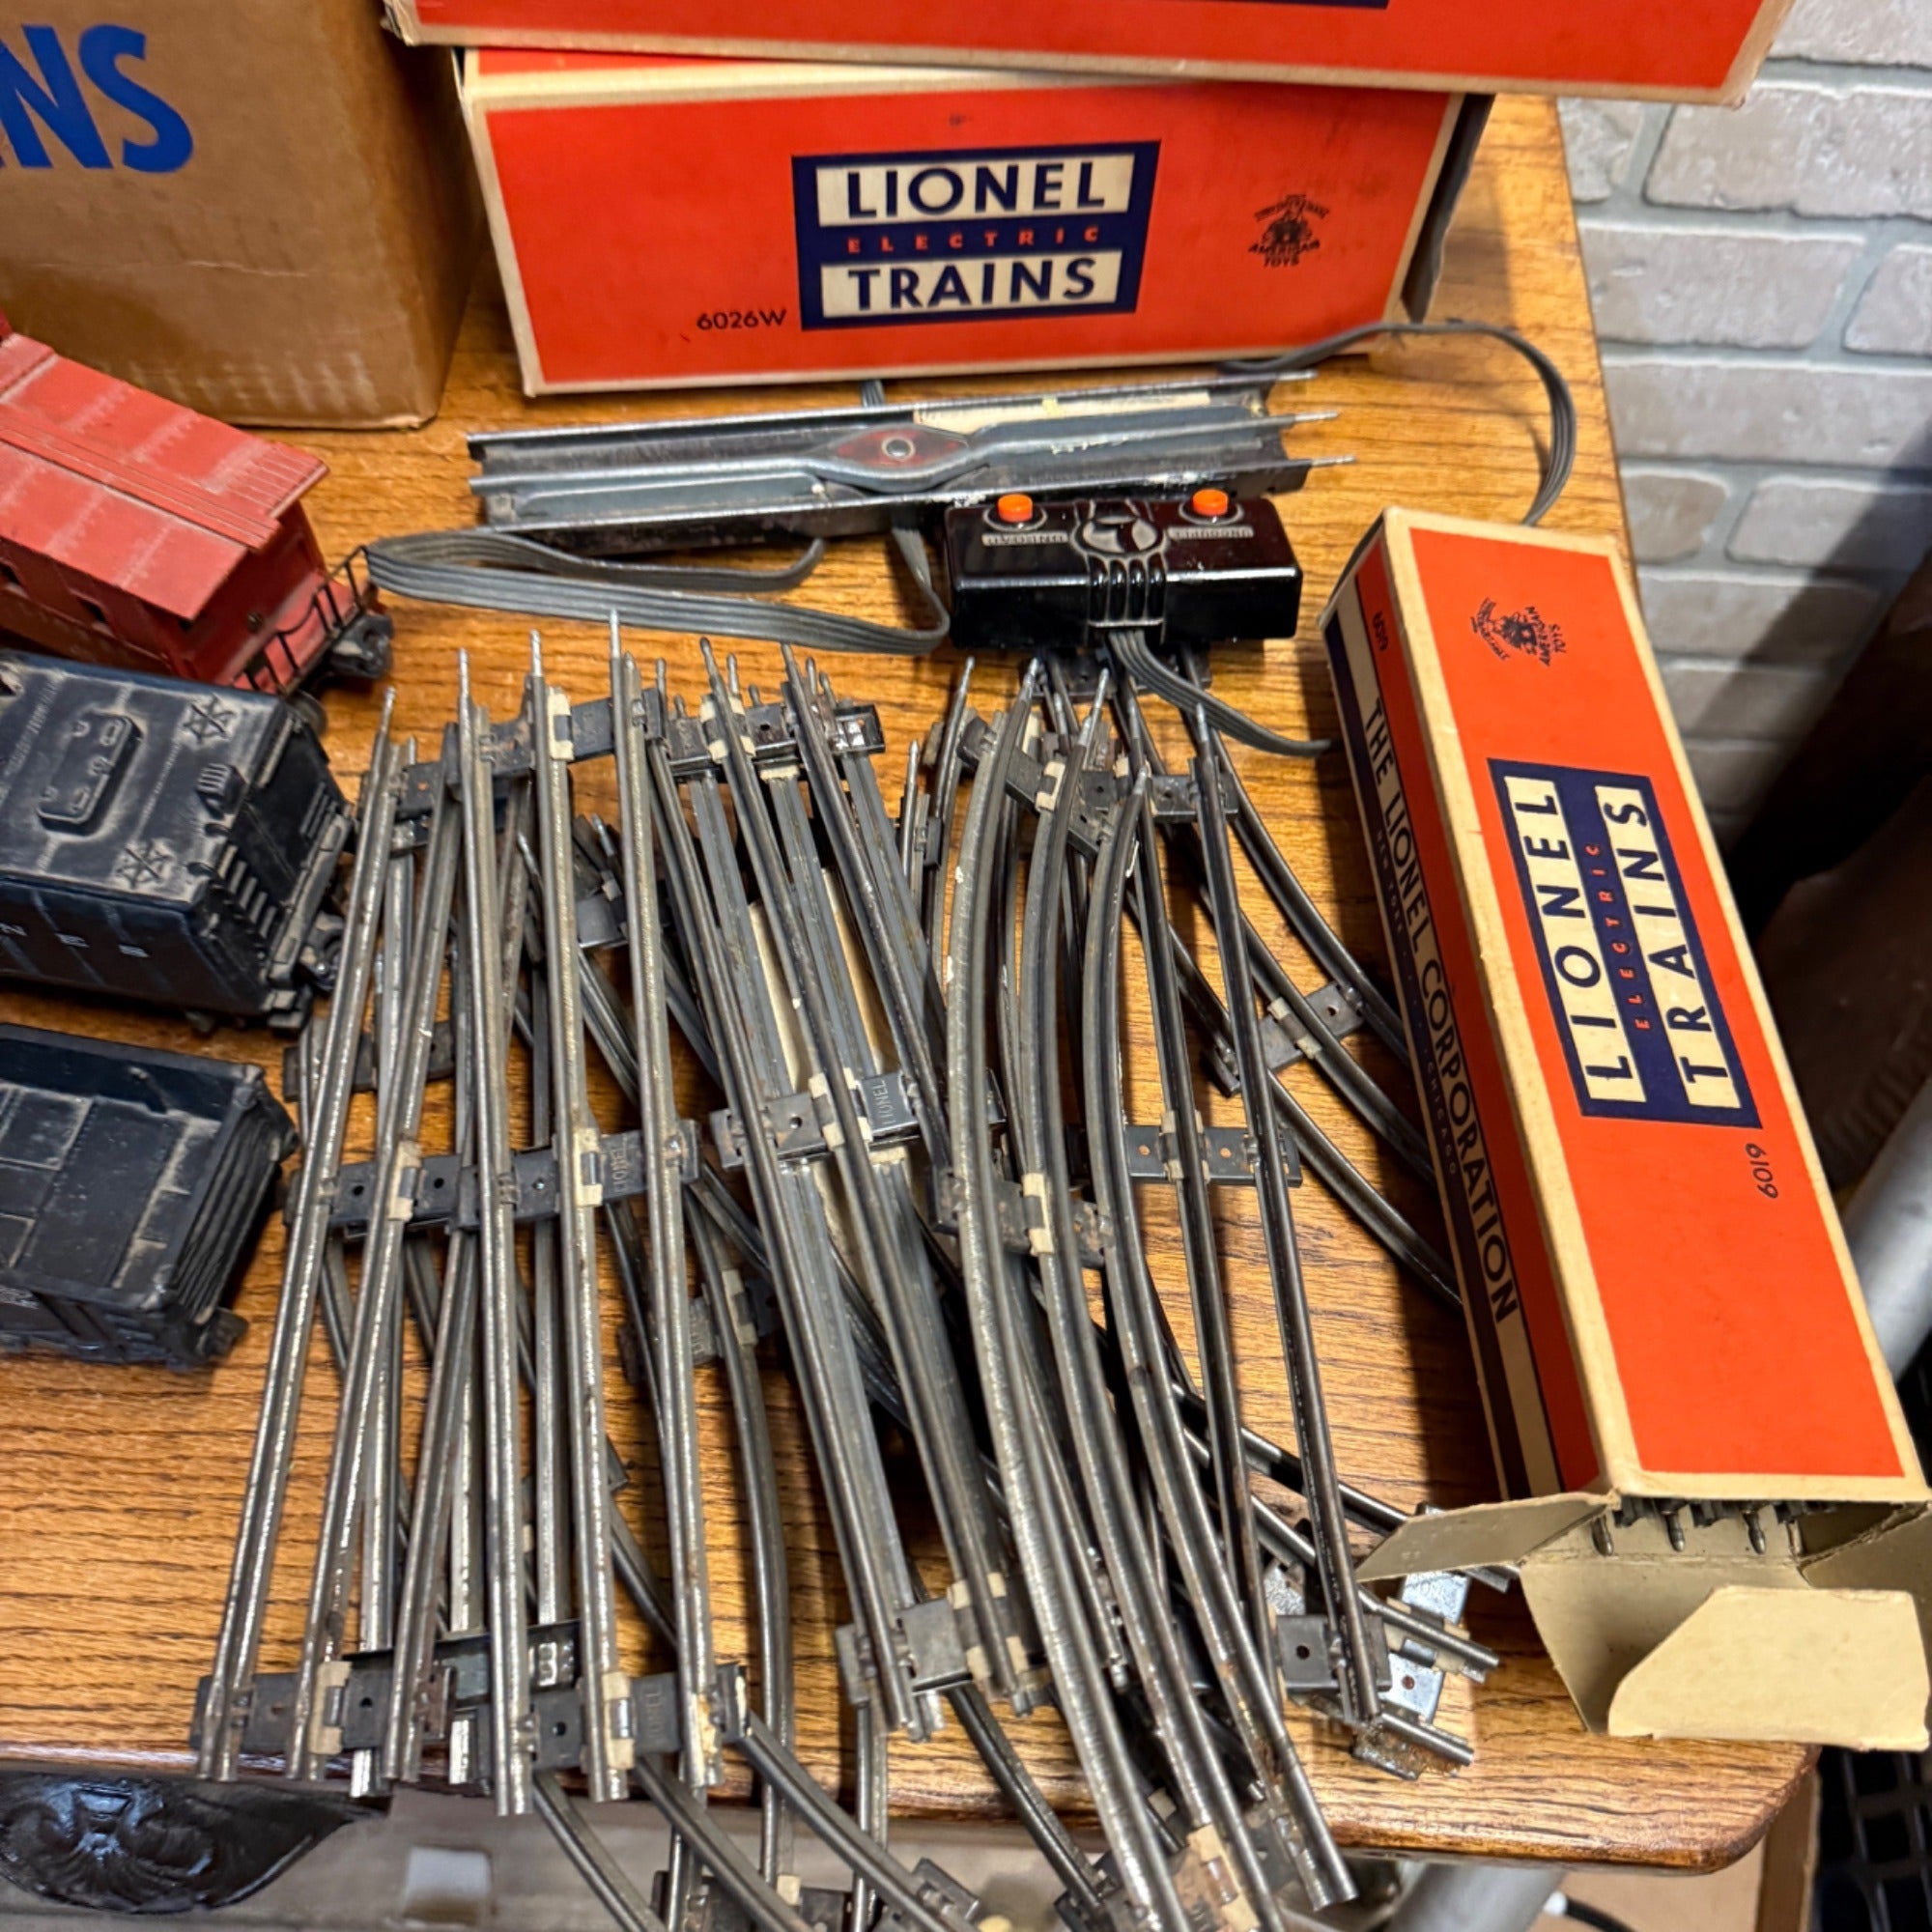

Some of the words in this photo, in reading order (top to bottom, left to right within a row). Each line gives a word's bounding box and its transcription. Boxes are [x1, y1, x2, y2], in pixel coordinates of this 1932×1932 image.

[847, 161, 1105, 218] LIONEL
[847, 226, 1100, 254] ELECTRIC
[848, 257, 1096, 311] TRAINS
[696, 308, 787, 331] 6026W
[1548, 623, 1567, 653] TOYS
[1386, 877, 1404, 933] YORK
[1515, 792, 1633, 1081] LIONEL
[1584, 843, 1651, 1031] ELECTRIC
[1604, 801, 1730, 1083] TRAINS
[1365, 700, 1394, 779] THE
[1384, 792, 1428, 953] LIONEL
[1421, 960, 1518, 1321] CORPORATION
[872, 1079, 895, 1125] LIONEL
[1426, 1060, 1457, 1176] CHICAGO
[610, 1144, 629, 1194] LIONEL
[1745, 1143, 1778, 1200] 6019
